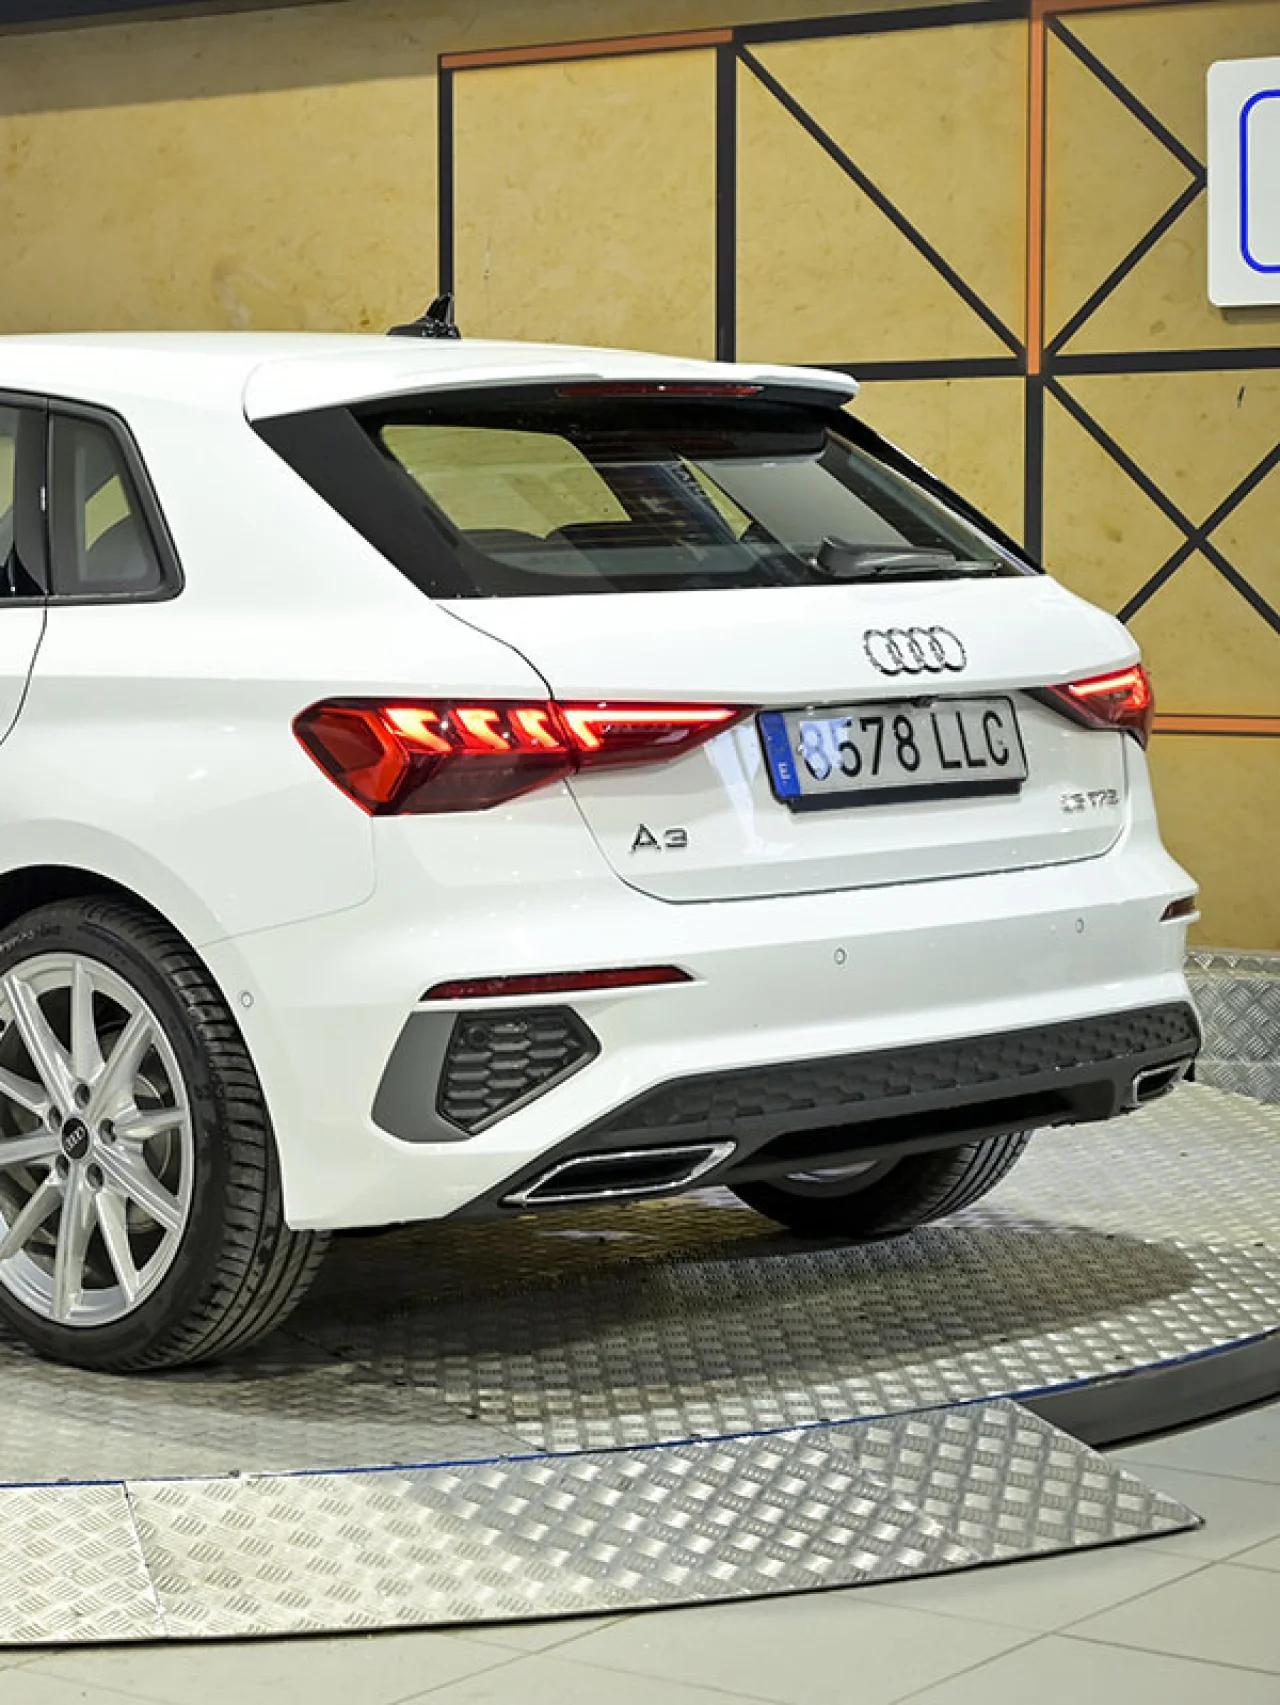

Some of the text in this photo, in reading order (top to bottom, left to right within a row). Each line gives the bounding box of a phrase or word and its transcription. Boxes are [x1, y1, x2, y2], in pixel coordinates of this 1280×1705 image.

[800, 710, 1008, 781] 8578 LLC
[778, 762, 791, 781] E
[629, 824, 688, 853] A3
